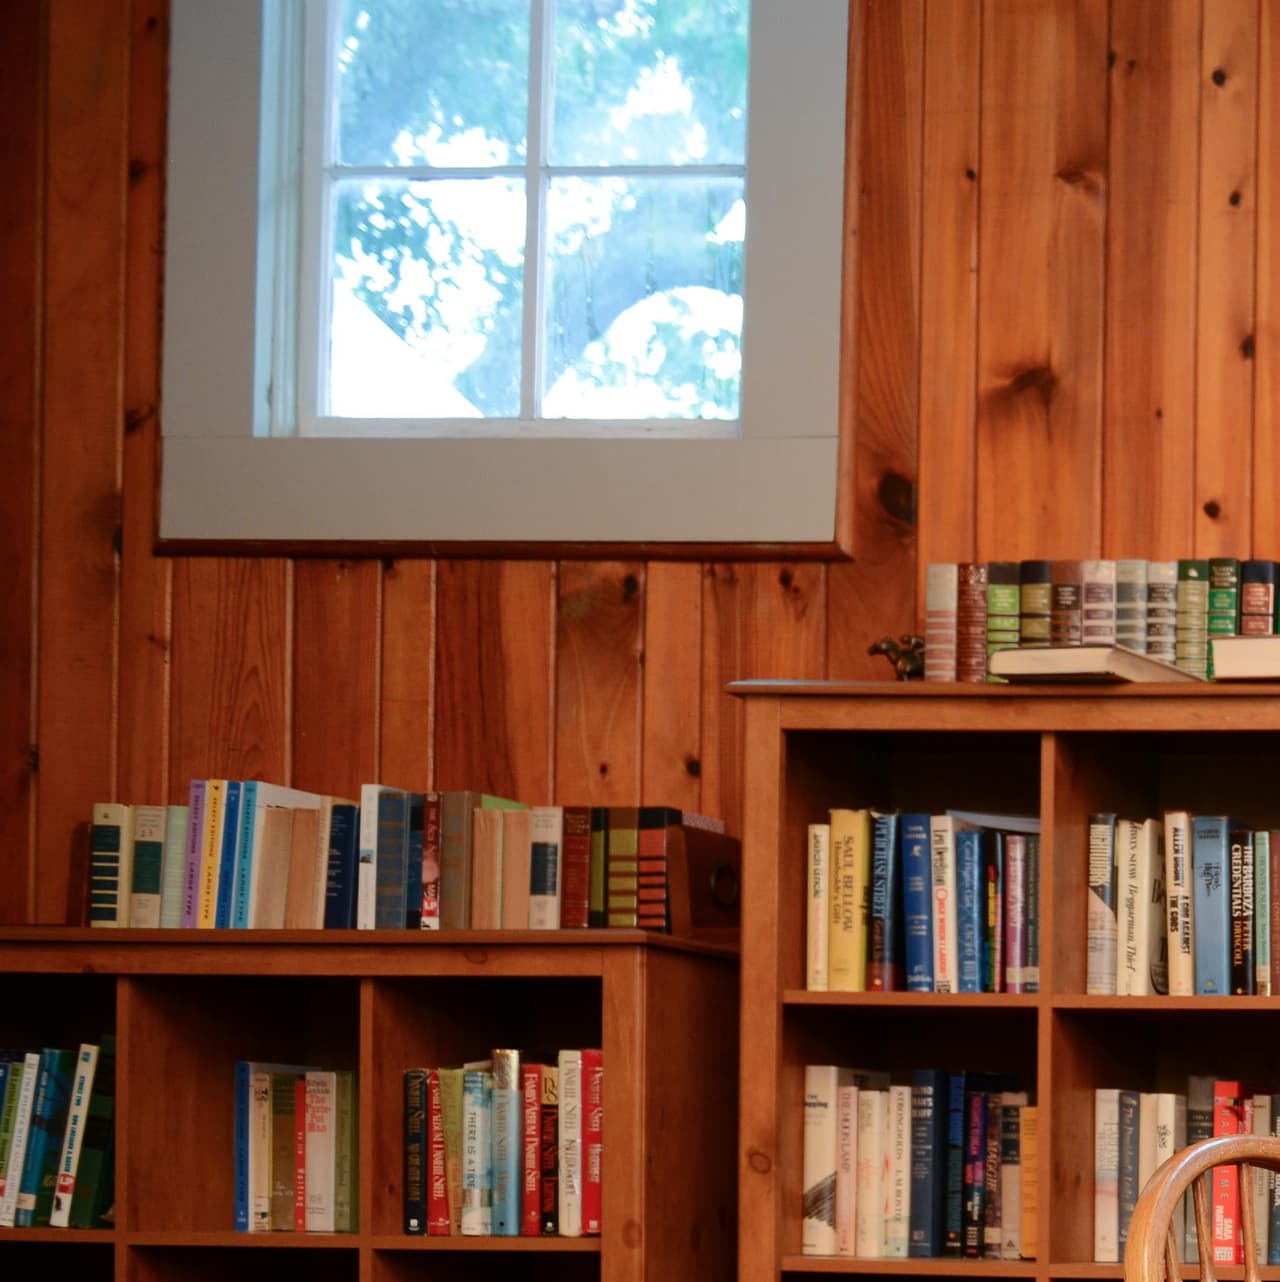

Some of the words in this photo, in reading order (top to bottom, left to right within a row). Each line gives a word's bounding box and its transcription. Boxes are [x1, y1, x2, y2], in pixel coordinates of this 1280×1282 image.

[841, 836, 855, 869] SAUL
[1231, 844, 1242, 918] CREDENTIALS
[1242, 868, 1254, 917] BARBOZA
[841, 875, 856, 933] BELLOW
[1170, 911, 1179, 932] GODS
[1243, 920, 1252, 951] PETER
[1232, 920, 1243, 967] DRISCOLL
[524, 1073, 540, 1103] FAMILY
[467, 1111, 477, 1141] THERE
[524, 1103, 540, 1136] ALBUM
[467, 1144, 477, 1156] IS
[467, 1159, 477, 1167] A
[985, 1139, 1000, 1192] MAGGIE
[467, 1168, 477, 1189] TIDE
[1224, 1218, 1233, 1240] SARA
